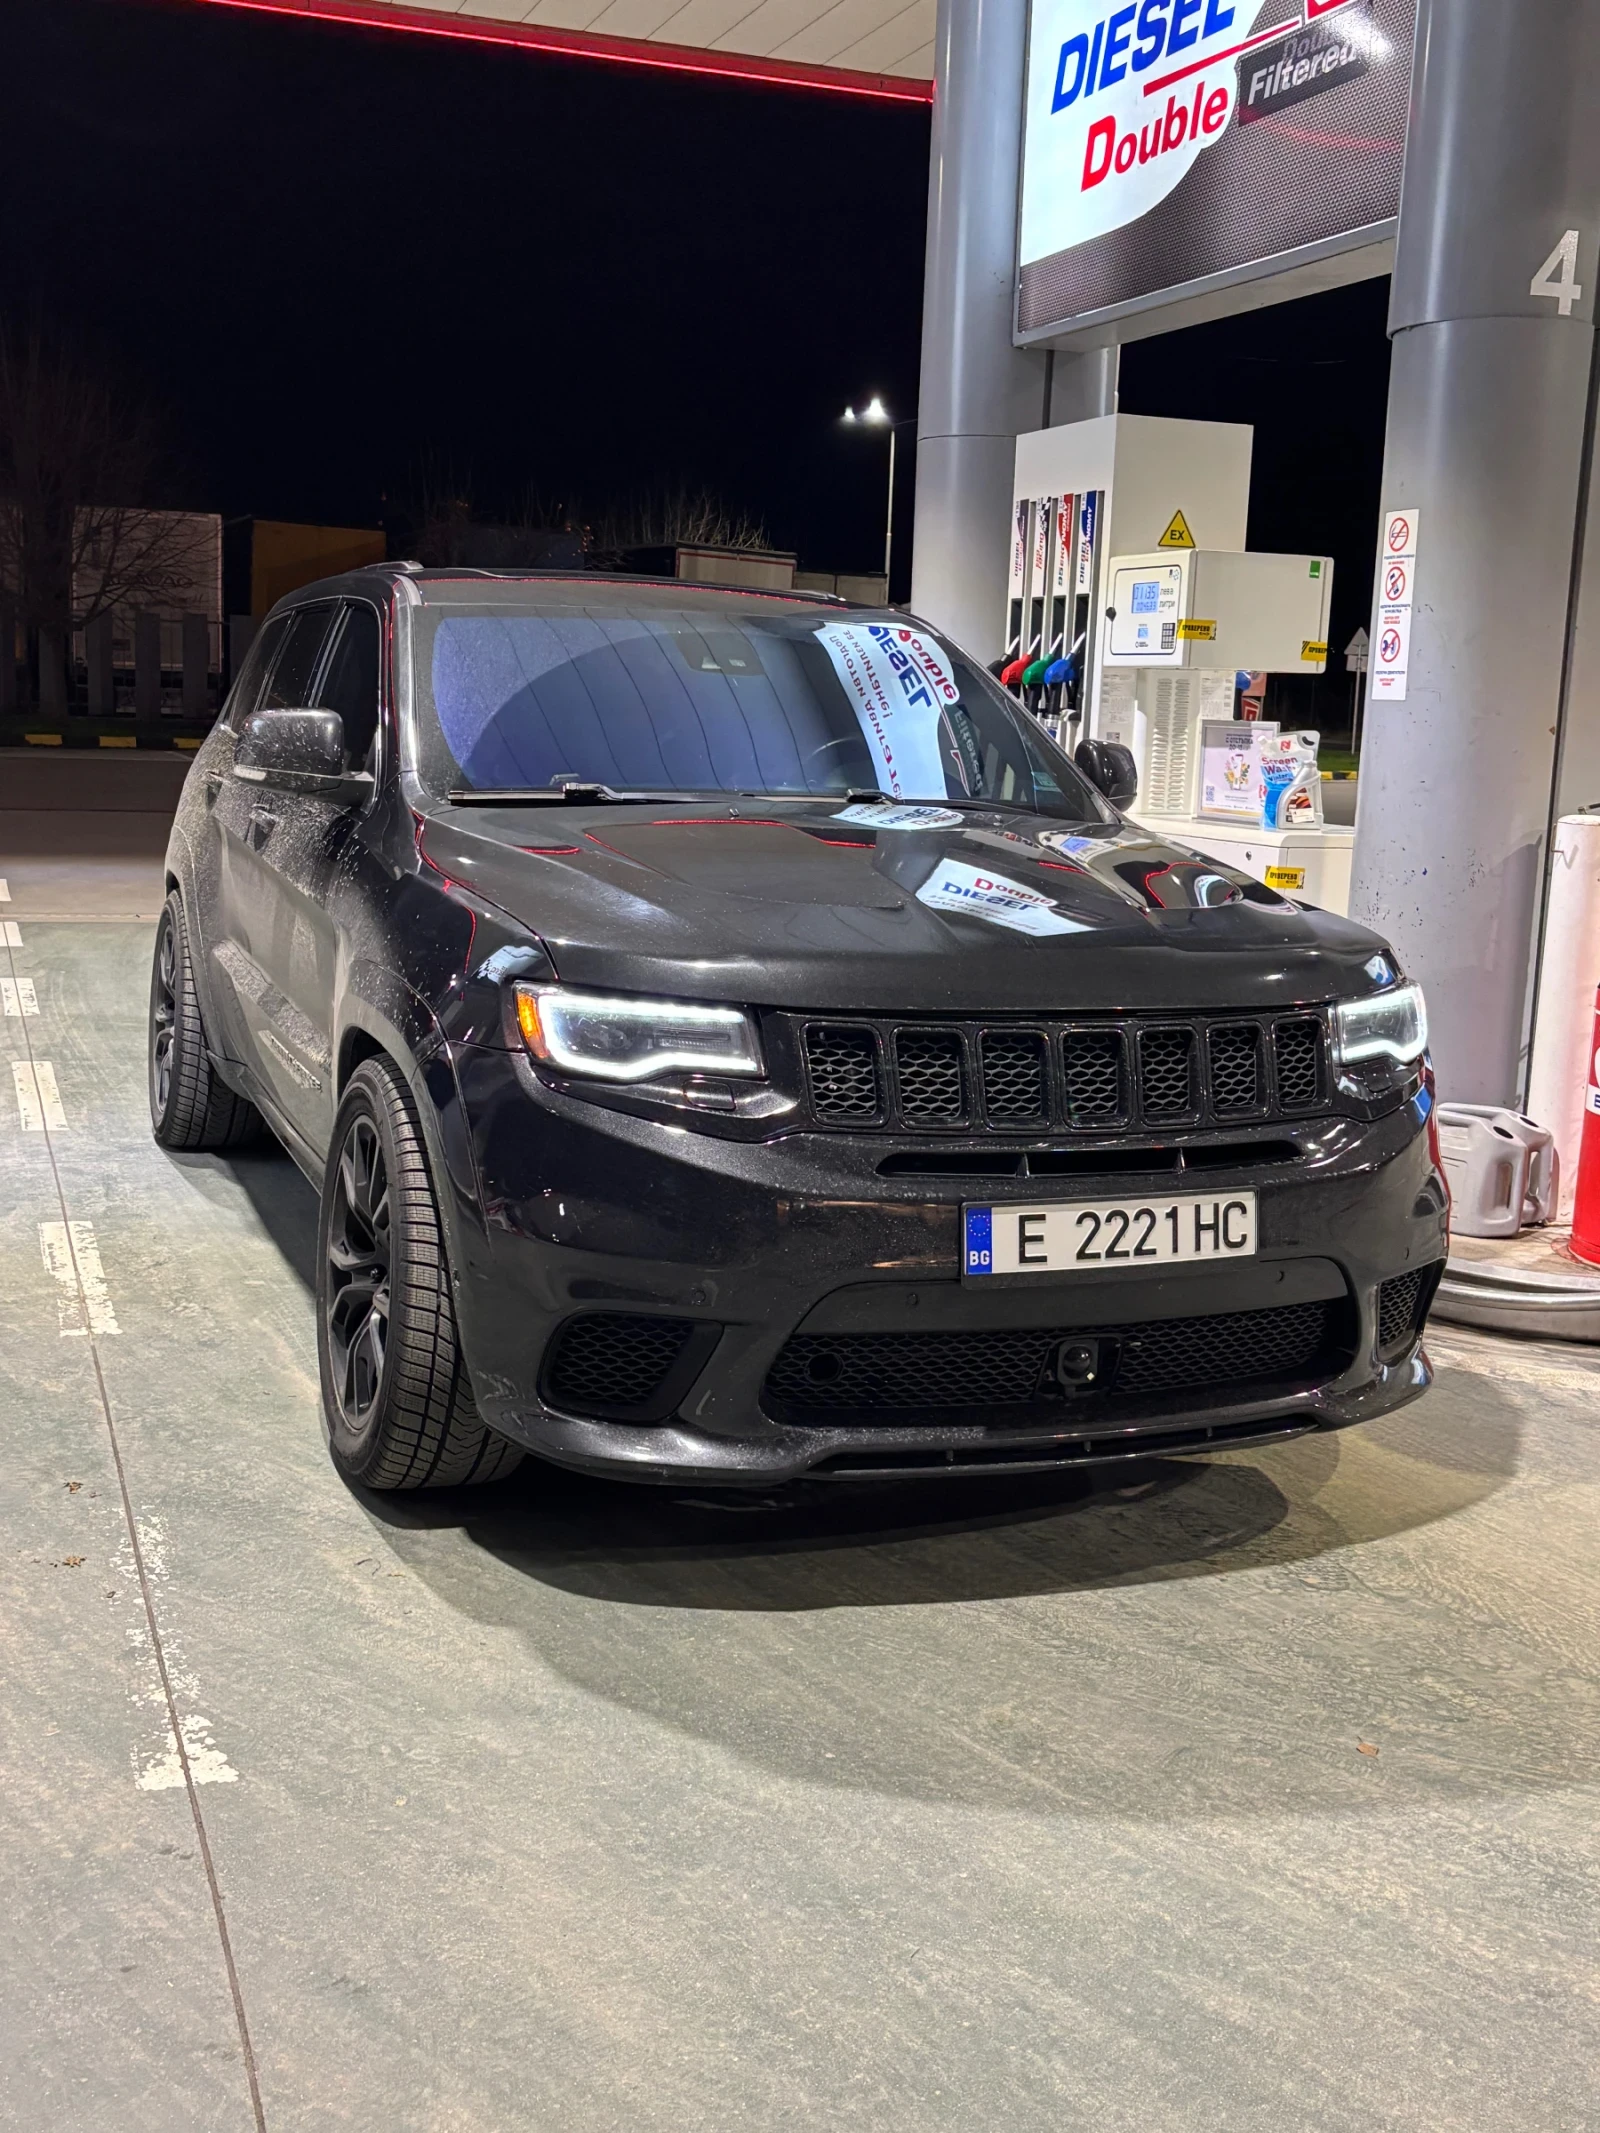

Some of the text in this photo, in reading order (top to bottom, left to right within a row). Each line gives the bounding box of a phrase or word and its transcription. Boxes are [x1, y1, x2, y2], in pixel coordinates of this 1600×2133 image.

[1051, 0, 1236, 114] DIESEL
[1247, 43, 1357, 106] Filtered
[1080, 82, 1229, 193] Double
[1530, 229, 1582, 315] 4
[1079, 540, 1087, 584] DIESEL
[1170, 530, 1185, 541] EX
[1261, 756, 1298, 765] Screen
[1264, 764, 1292, 775] Wash
[969, 1250, 990, 1266] BG
[1018, 1200, 1248, 1264] E 2221 HC
